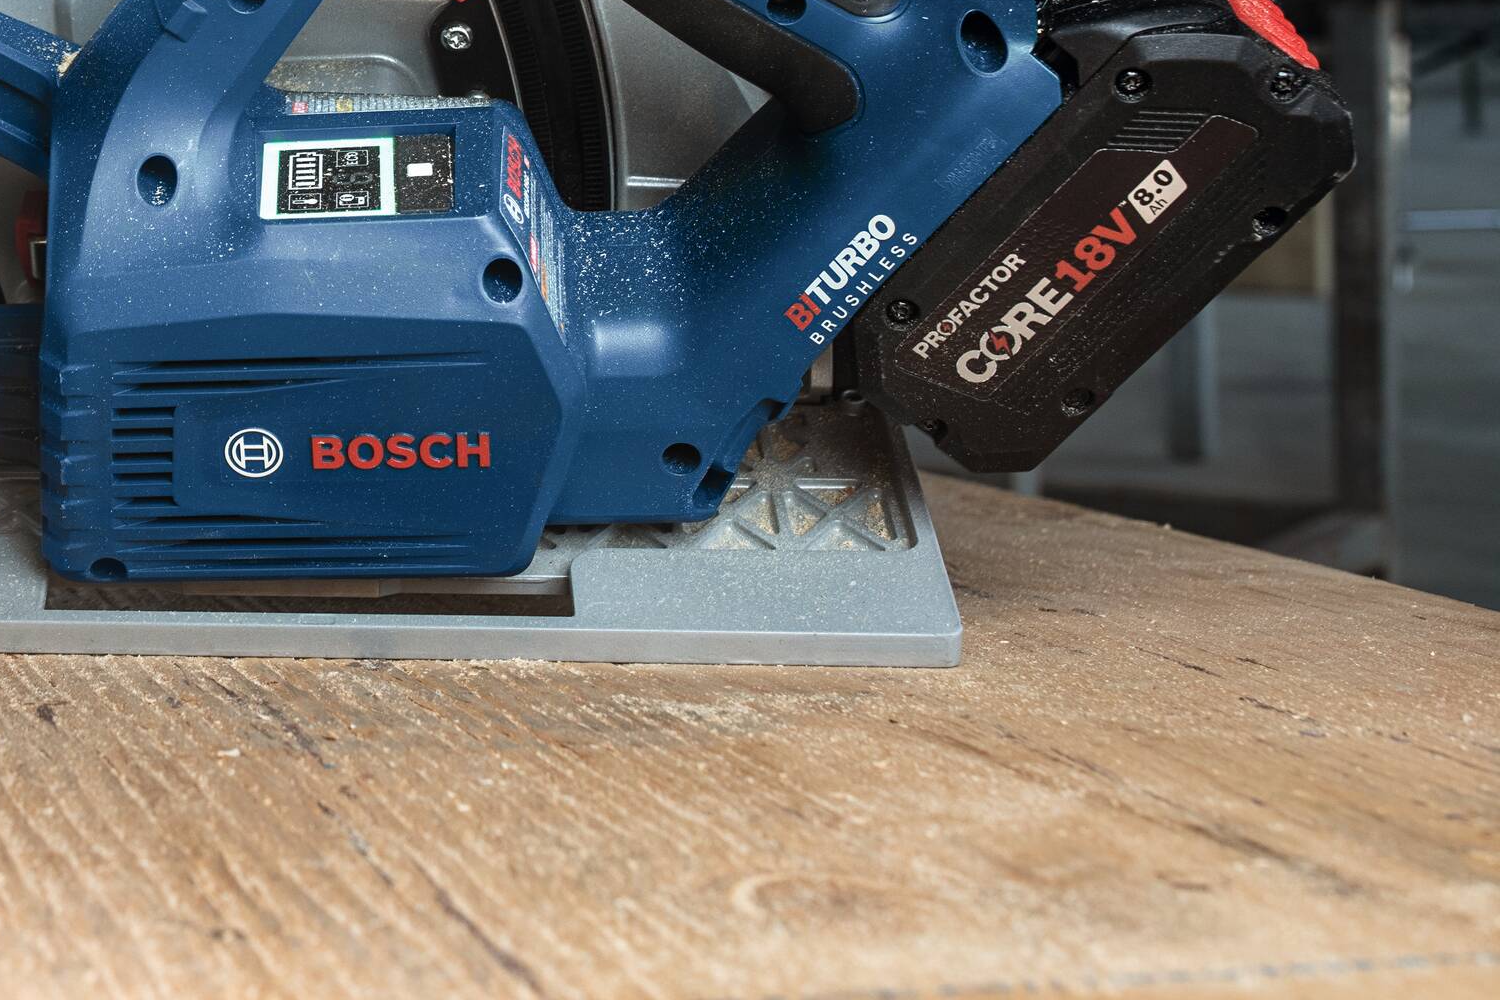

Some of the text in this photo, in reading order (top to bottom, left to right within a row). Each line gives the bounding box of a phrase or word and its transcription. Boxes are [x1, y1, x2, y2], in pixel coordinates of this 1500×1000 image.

[1133, 169, 1174, 207] 8.0
[1149, 197, 1168, 216] Ah
[783, 214, 896, 332] BITURBO
[809, 232, 918, 345] BRUSHLESS
[912, 252, 1027, 359] PROFACTOR
[311, 431, 491, 469] BOSCH
